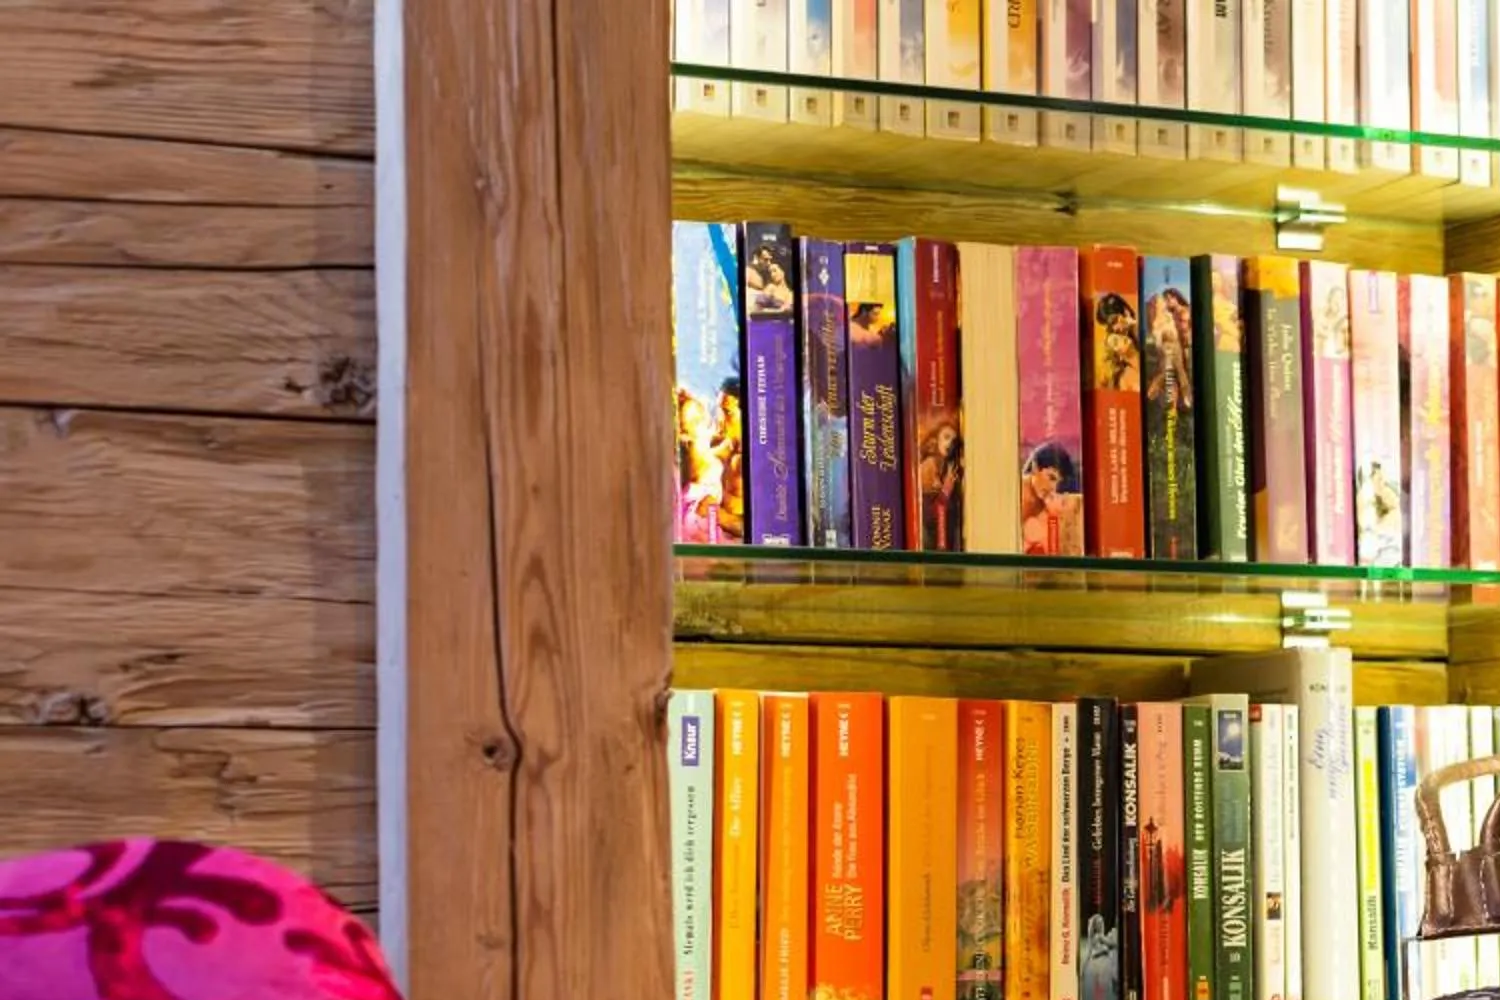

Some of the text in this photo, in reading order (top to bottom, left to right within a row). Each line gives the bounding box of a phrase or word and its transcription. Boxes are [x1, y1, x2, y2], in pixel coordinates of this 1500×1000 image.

[856, 390, 878, 465] Sturm der
[1123, 743, 1138, 827] KONSALIK
[1192, 848, 1210, 899] KONSALIK
[1220, 847, 1248, 948] KONSALIK
[823, 883, 844, 937] ANNE
[843, 883, 864, 941] PERRY
